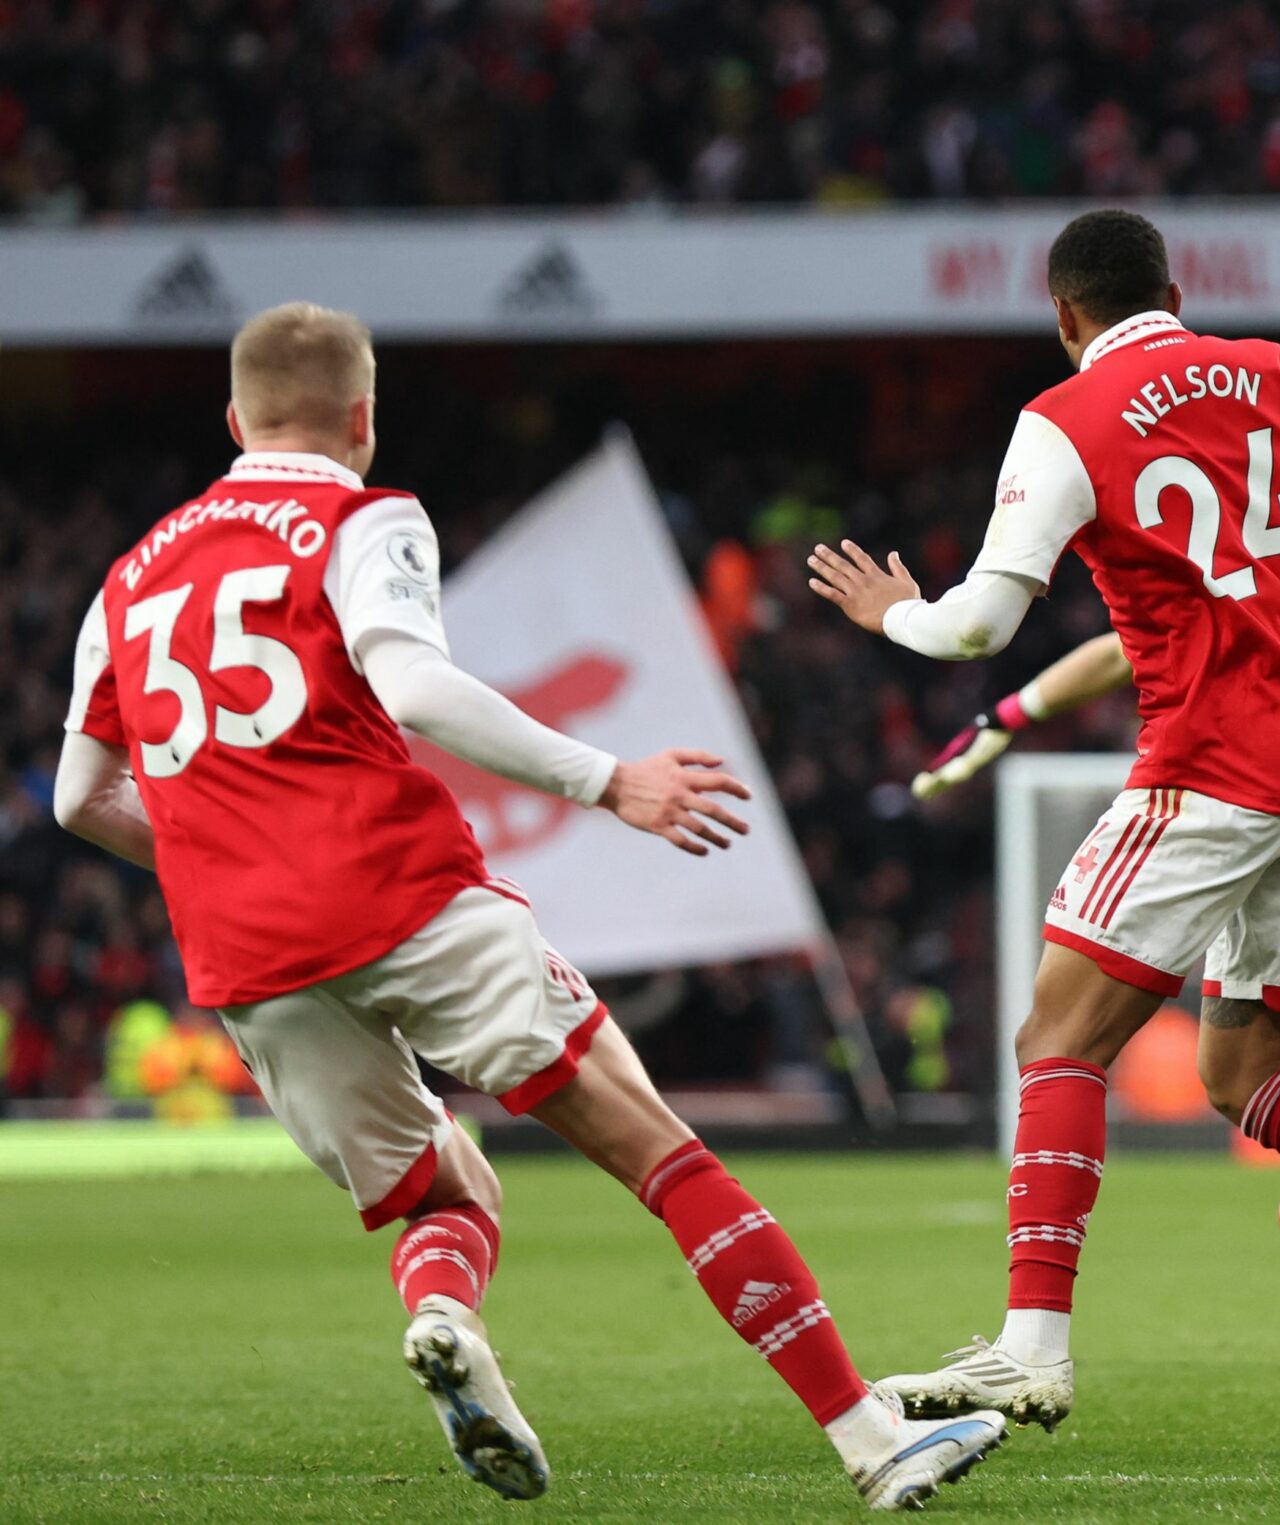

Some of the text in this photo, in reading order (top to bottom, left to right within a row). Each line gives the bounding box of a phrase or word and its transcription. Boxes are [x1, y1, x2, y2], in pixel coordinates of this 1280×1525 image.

[1121, 364, 1262, 438] NELSON
[124, 564, 308, 779] 35
[732, 1282, 792, 1328] adidas
